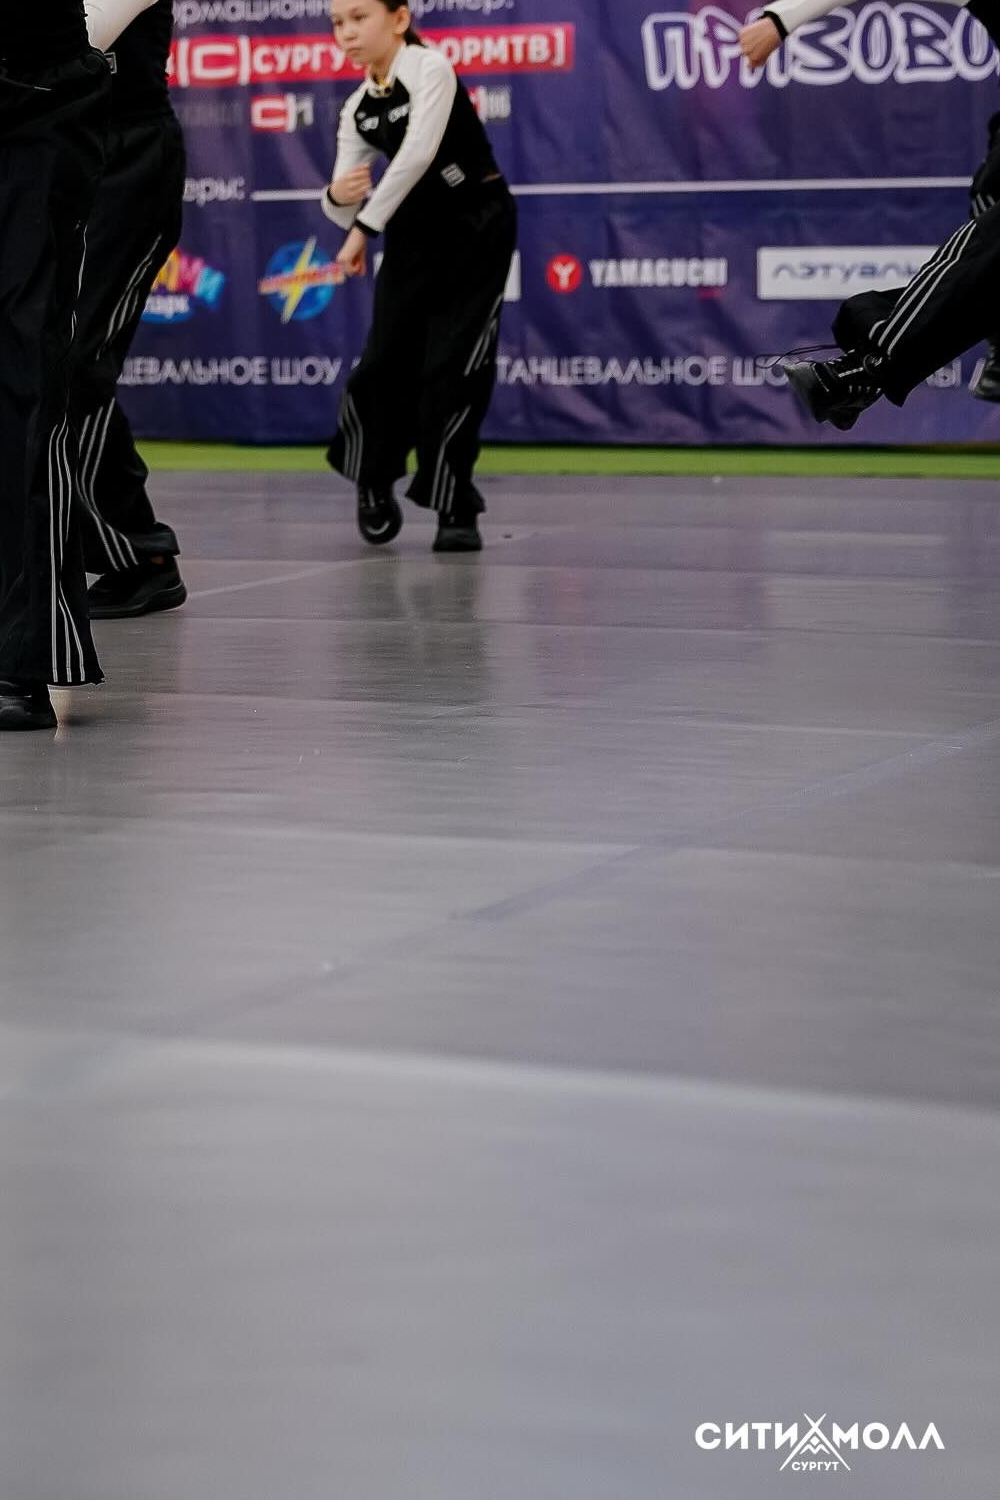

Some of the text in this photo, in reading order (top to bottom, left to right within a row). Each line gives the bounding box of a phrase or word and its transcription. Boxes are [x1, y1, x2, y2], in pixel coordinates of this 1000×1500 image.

[589, 257, 728, 287] YAMAGUCHI
[271, 355, 343, 386] ШОУ
[497, 355, 800, 386] ТАНЦЕВАЛЬНОЕ ШО
